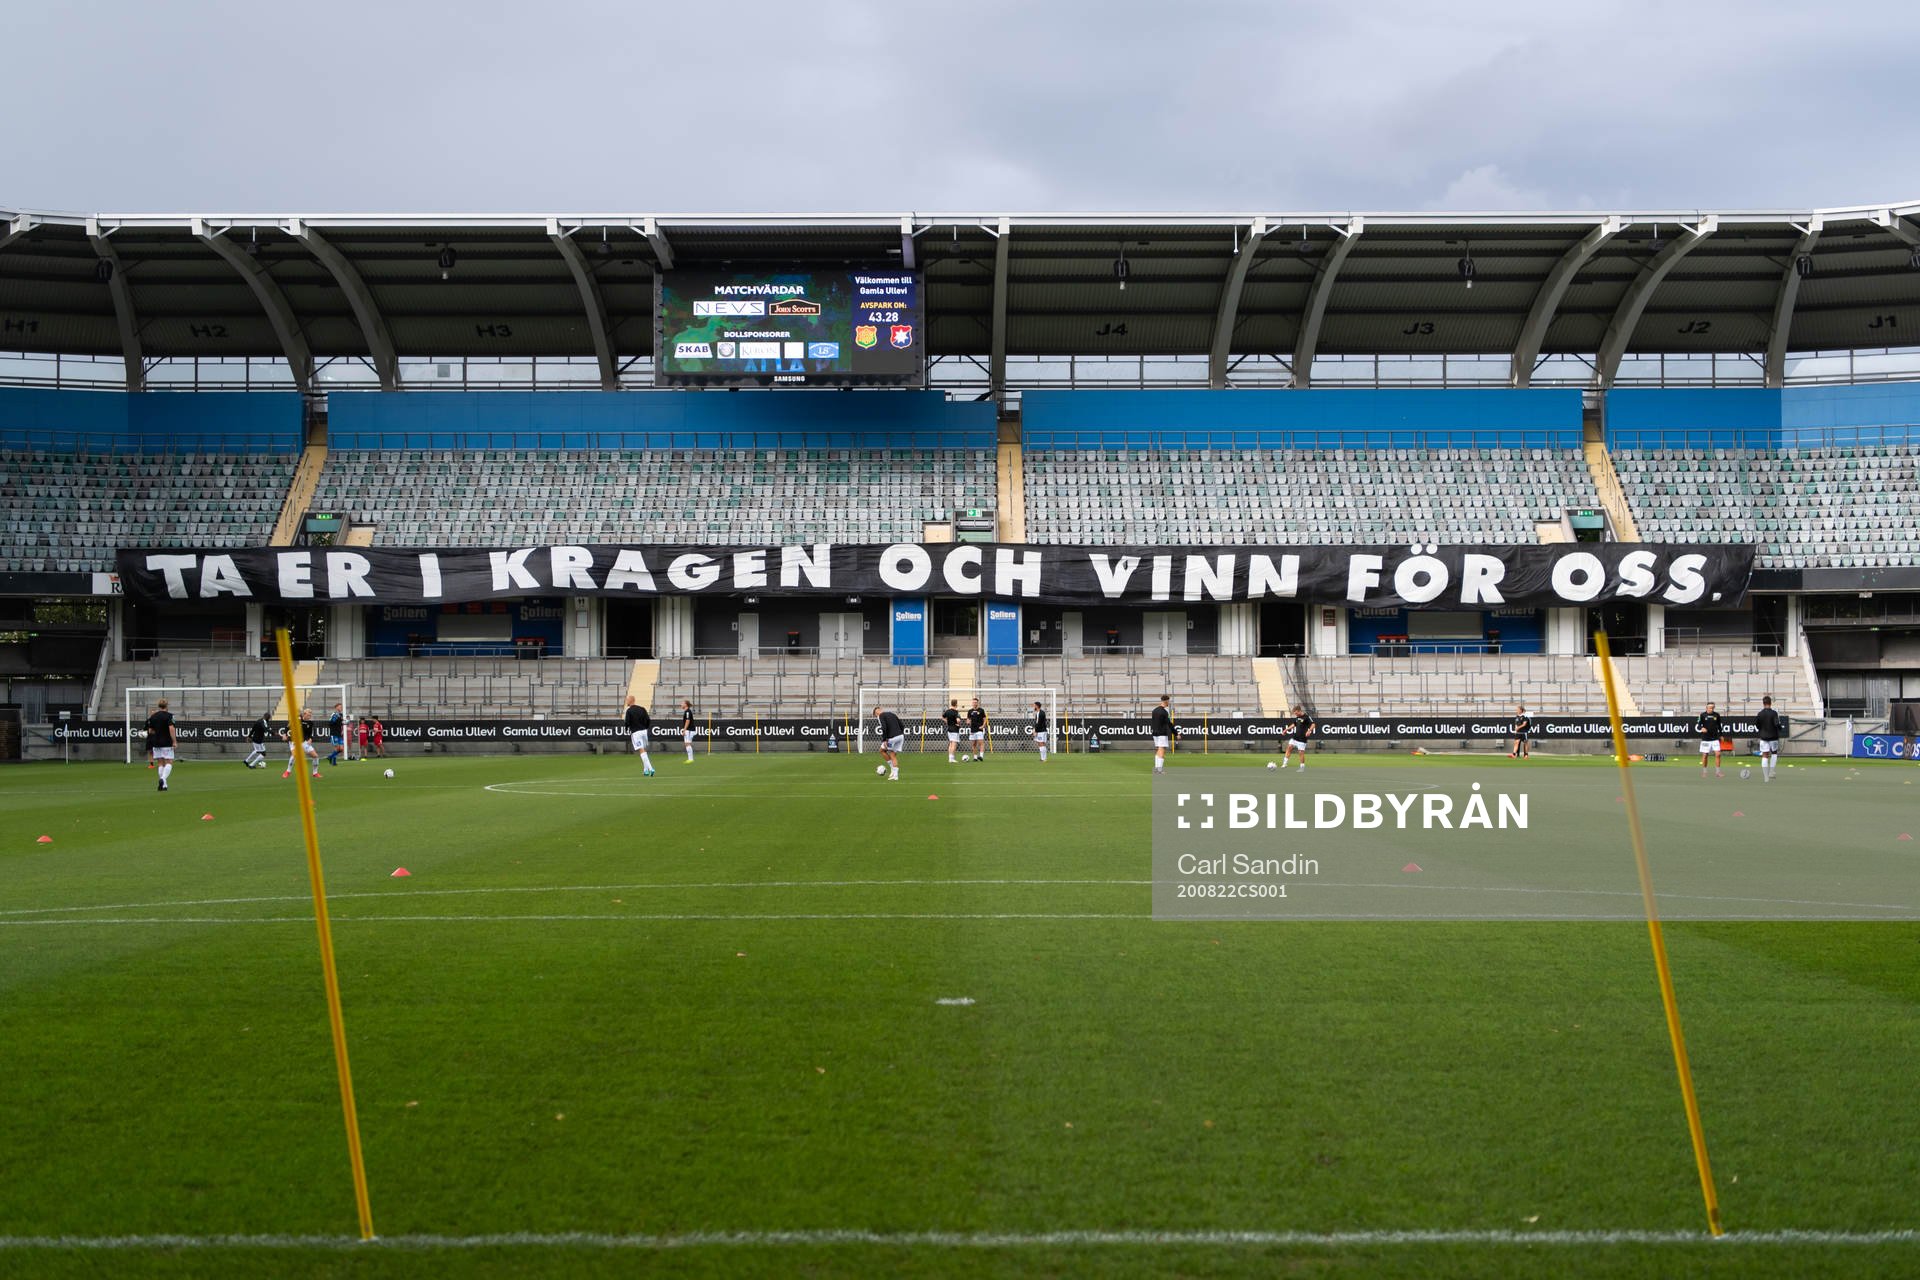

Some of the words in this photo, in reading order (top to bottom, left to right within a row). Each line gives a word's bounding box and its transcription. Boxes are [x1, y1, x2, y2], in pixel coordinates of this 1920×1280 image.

[855, 276, 900, 284] Välkommen
[901, 276, 912, 284] till
[714, 284, 804, 295] MATCHVÄRDAR
[860, 286, 884, 295] Gamla
[886, 286, 908, 295] Ullevi
[696, 303, 762, 313] NEVS
[868, 312, 899, 322] 43.28
[1868, 315, 1897, 328] J1
[4, 319, 40, 333] H1
[190, 324, 229, 338] H2
[475, 324, 513, 338] H3
[1095, 323, 1128, 336] J4
[1402, 322, 1434, 335] J3
[1677, 321, 1711, 334] J2
[146, 554, 253, 598] TA
[277, 551, 376, 599] ER
[419, 553, 442, 598] I
[489, 544, 831, 592] KRAGEN
[879, 543, 1043, 598] OCH
[1089, 553, 1301, 602] VINN
[1347, 543, 1506, 604] FÖR
[1552, 550, 1722, 604] OSS.
[384, 606, 428, 621] Sofiero
[54, 728, 90, 738] Gamla
[92, 728, 122, 738] Ullevi
[204, 728, 239, 737] Gamla
[391, 727, 421, 737] Ullevi
[428, 727, 463, 737] Gamla
[465, 727, 496, 737] Ullevi
[503, 727, 538, 736] Gamla
[540, 727, 570, 736] Ullevi
[578, 726, 613, 736] Gamla
[726, 726, 762, 736] Gamla
[764, 726, 794, 736] Ullevi
[801, 726, 829, 735] Gaml
[1099, 725, 1134, 735] Gamla
[1211, 725, 1241, 735] Ullevi
[1248, 725, 1283, 735] Gamla
[1322, 724, 1357, 734] Gamla
[1360, 724, 1390, 734] Ullevi
[1397, 724, 1432, 734] Gamla
[1435, 724, 1465, 734] Ullevi
[1472, 724, 1507, 734] Gamla
[1546, 723, 1581, 734] Gamla
[1621, 723, 1656, 733] Gamla
[1658, 723, 1689, 733] Ullevi
